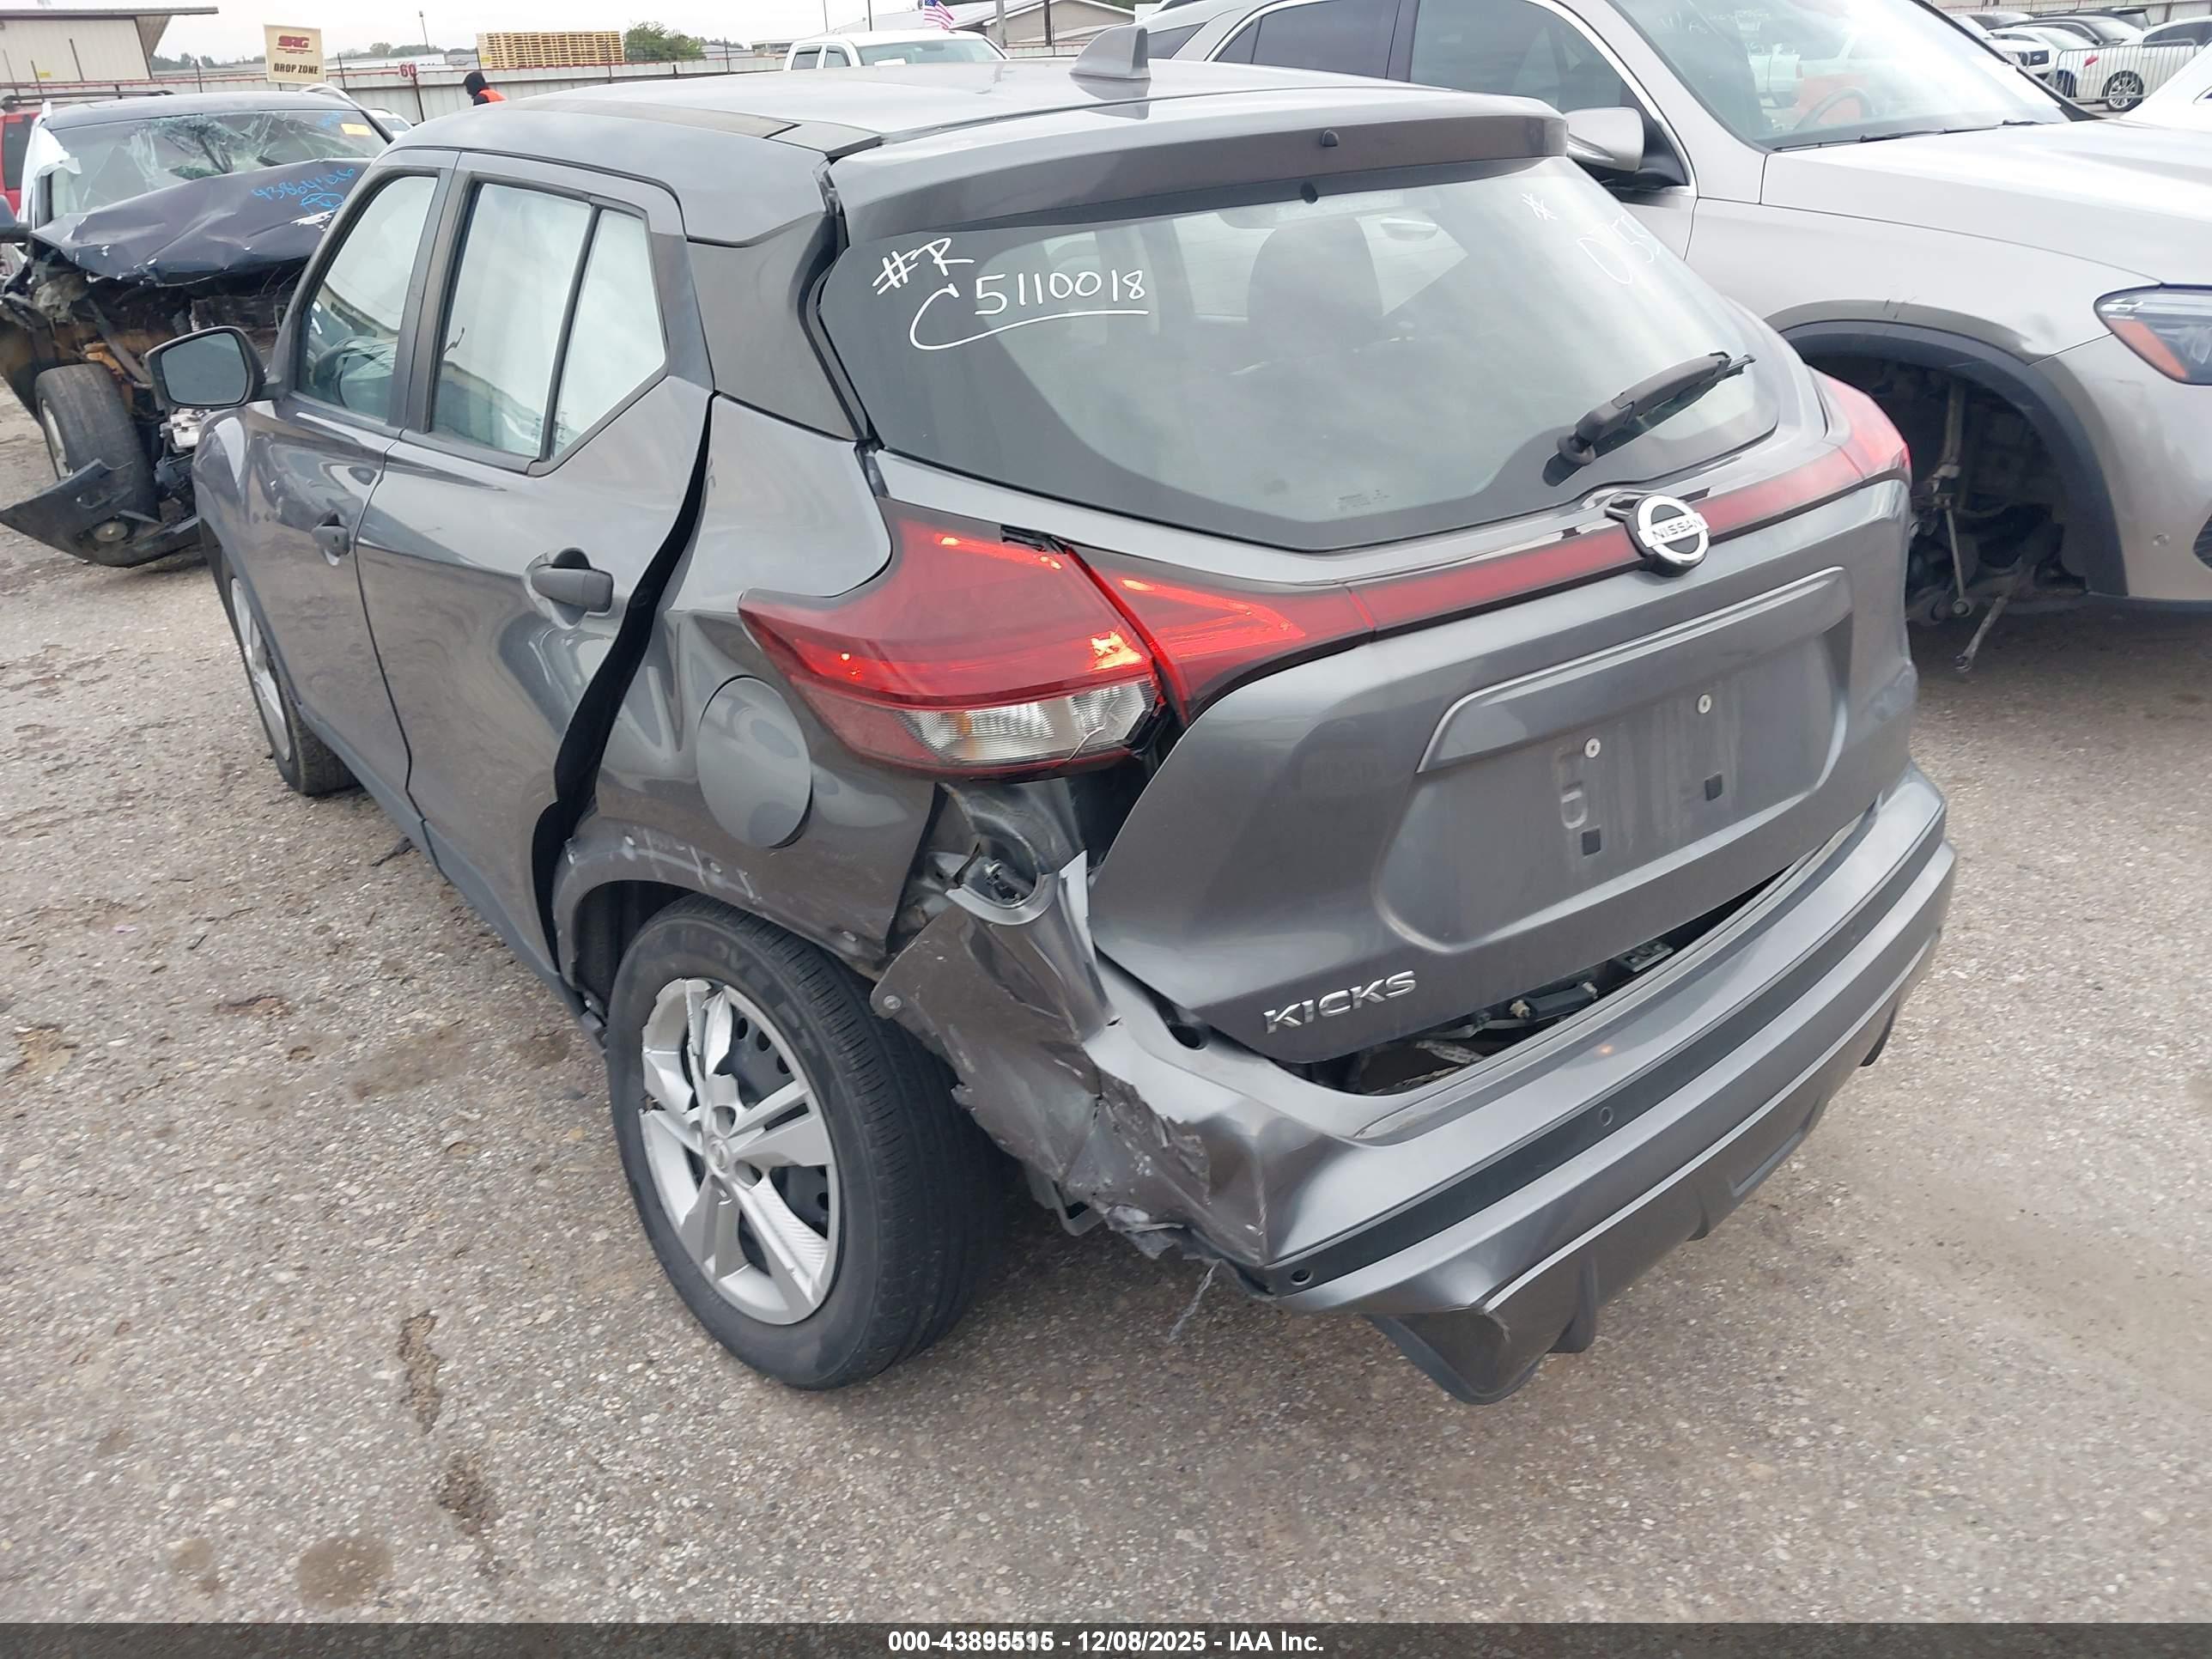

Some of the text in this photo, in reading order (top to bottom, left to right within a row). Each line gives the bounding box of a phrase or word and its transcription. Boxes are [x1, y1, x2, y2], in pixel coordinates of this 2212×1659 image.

[274, 63, 319, 75] DROP ZONE
[399, 64, 416, 77] 60
[1651, 519, 1704, 541] NISSAN
[1263, 970, 1416, 1034] KICKS
